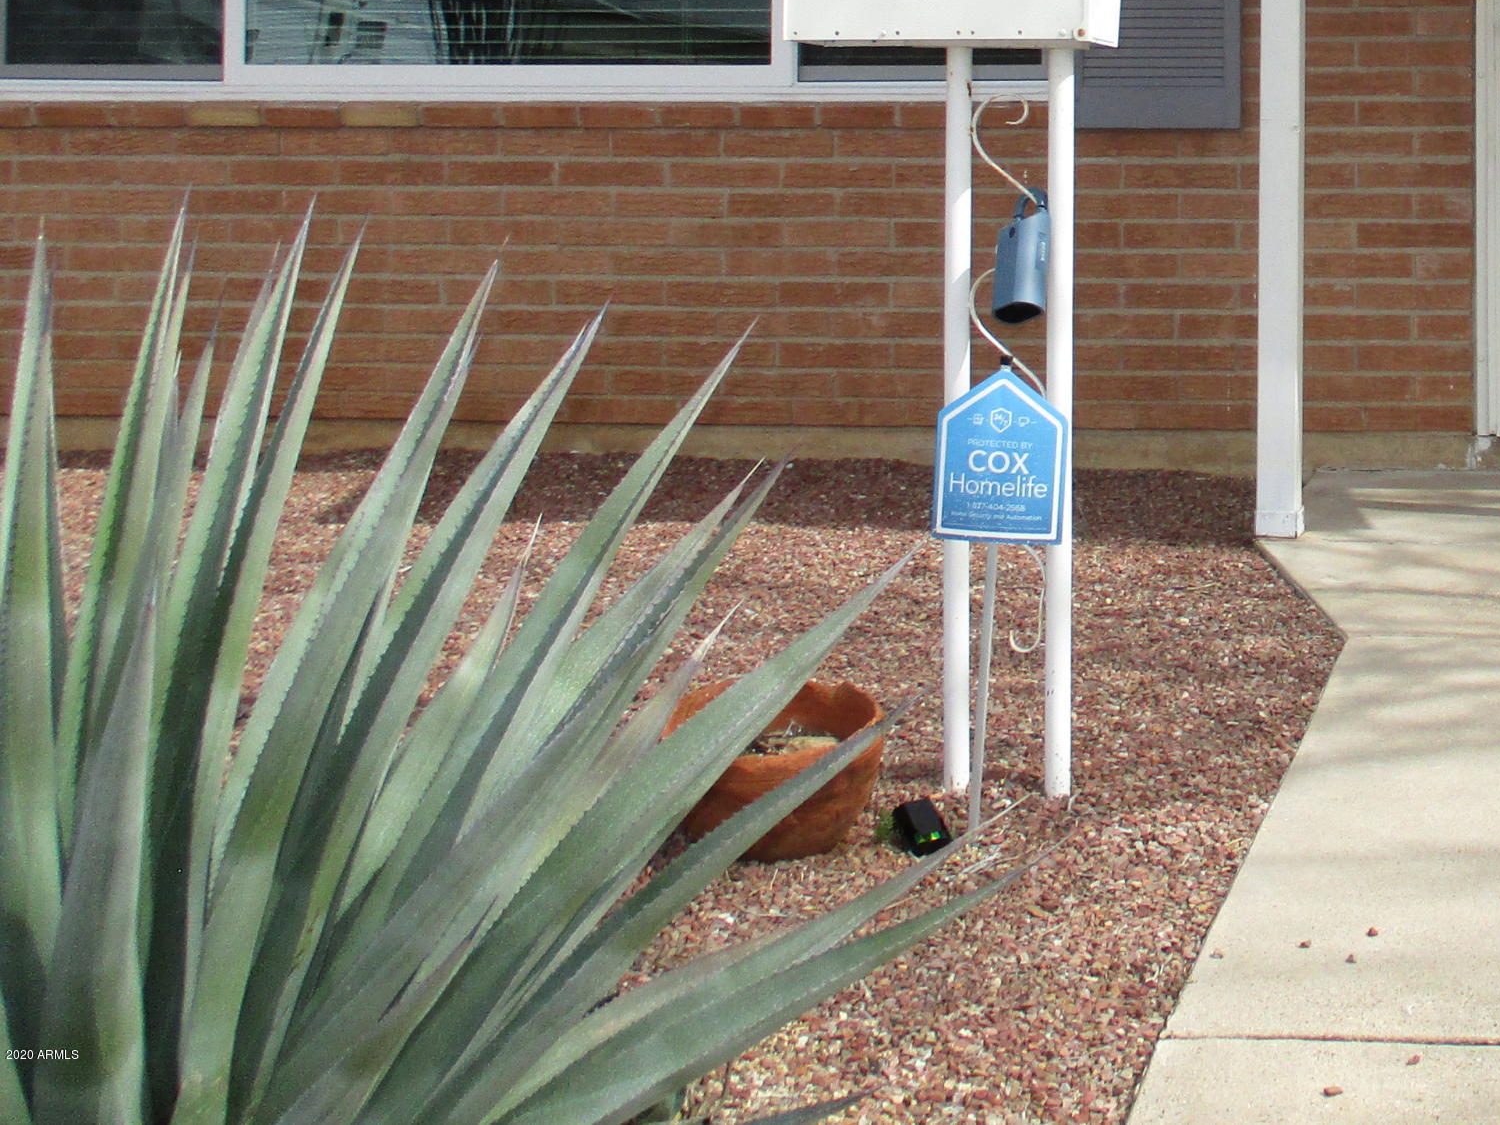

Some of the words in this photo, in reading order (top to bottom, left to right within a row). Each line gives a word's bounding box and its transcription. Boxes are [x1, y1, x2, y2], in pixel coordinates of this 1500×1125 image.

[967, 438, 1018, 449] PROTECTED
[1020, 441, 1033, 450] BY
[968, 449, 1030, 475] COX
[949, 472, 1048, 499] Homelife
